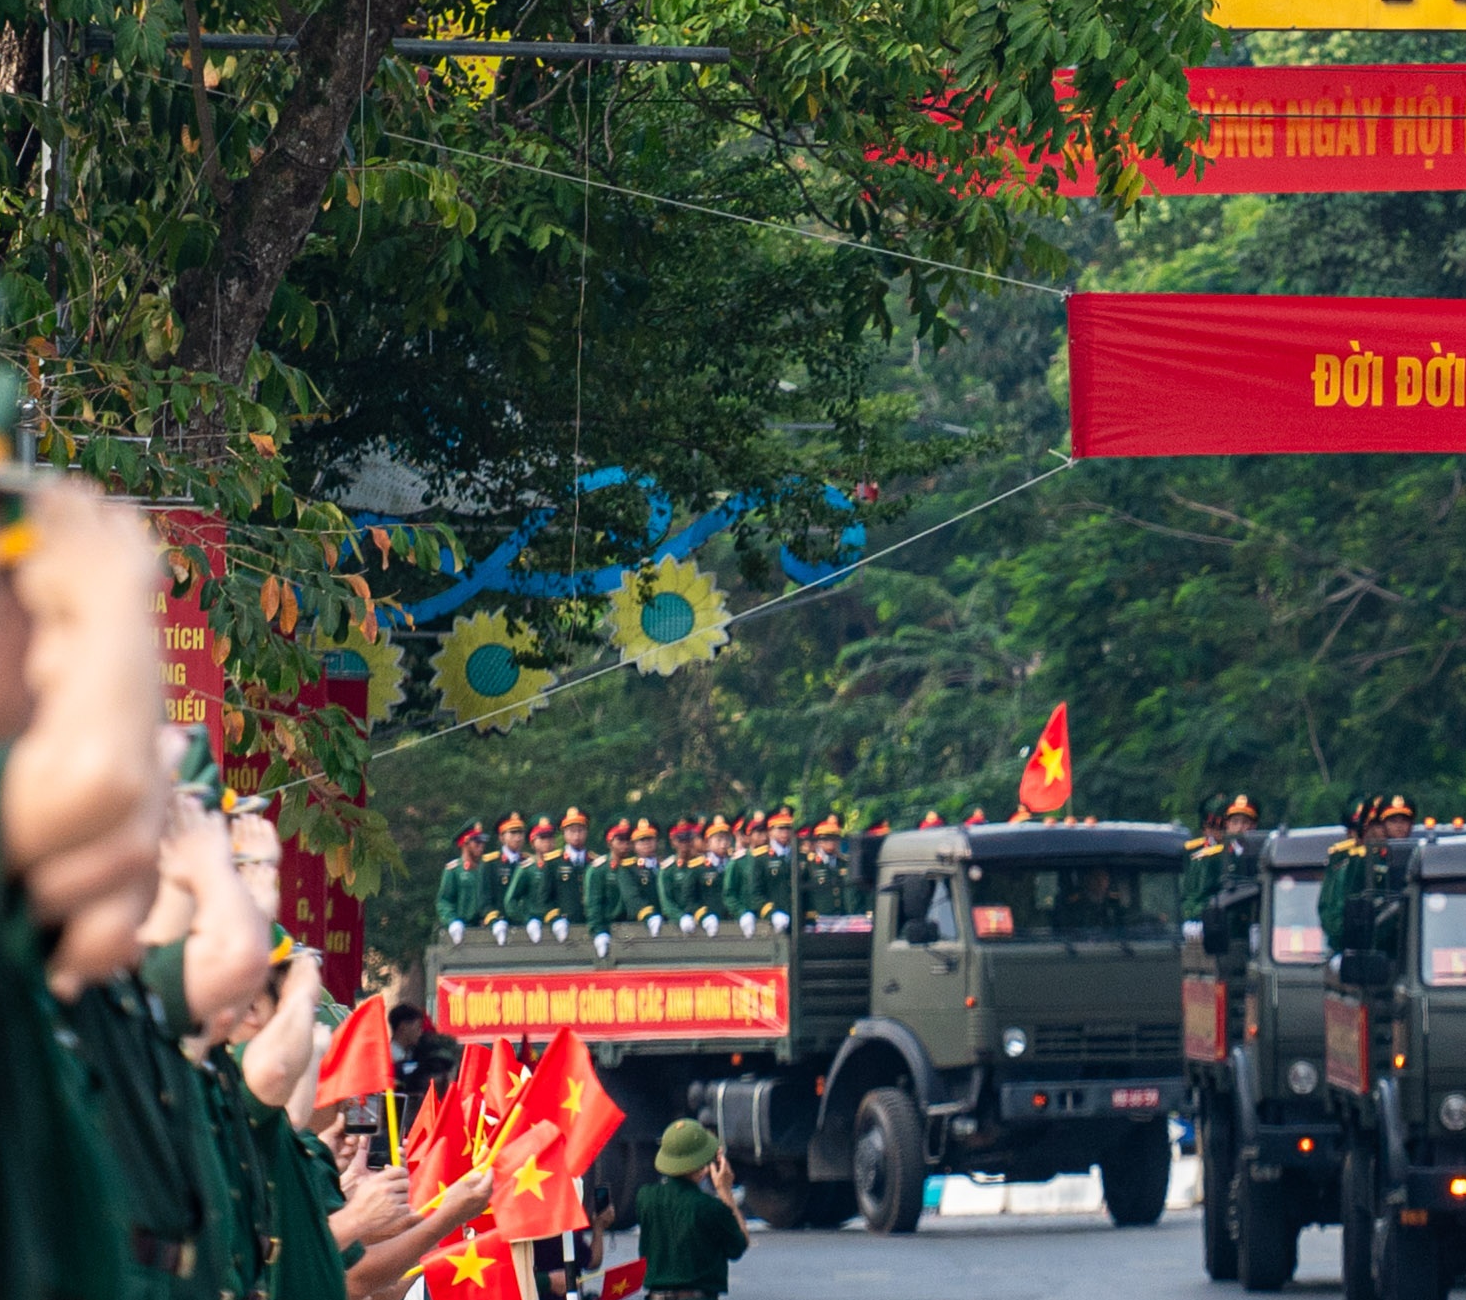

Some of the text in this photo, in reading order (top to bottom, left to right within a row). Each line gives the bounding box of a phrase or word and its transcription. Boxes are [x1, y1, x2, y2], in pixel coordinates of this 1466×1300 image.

[1285, 86, 1383, 158] NGÀY
[1392, 84, 1454, 170] HỘI
[1310, 340, 1384, 407] ĐỜI
[1395, 342, 1466, 408] ĐỜI
[164, 623, 205, 650] TÍCH
[165, 690, 206, 722] BIỂU
